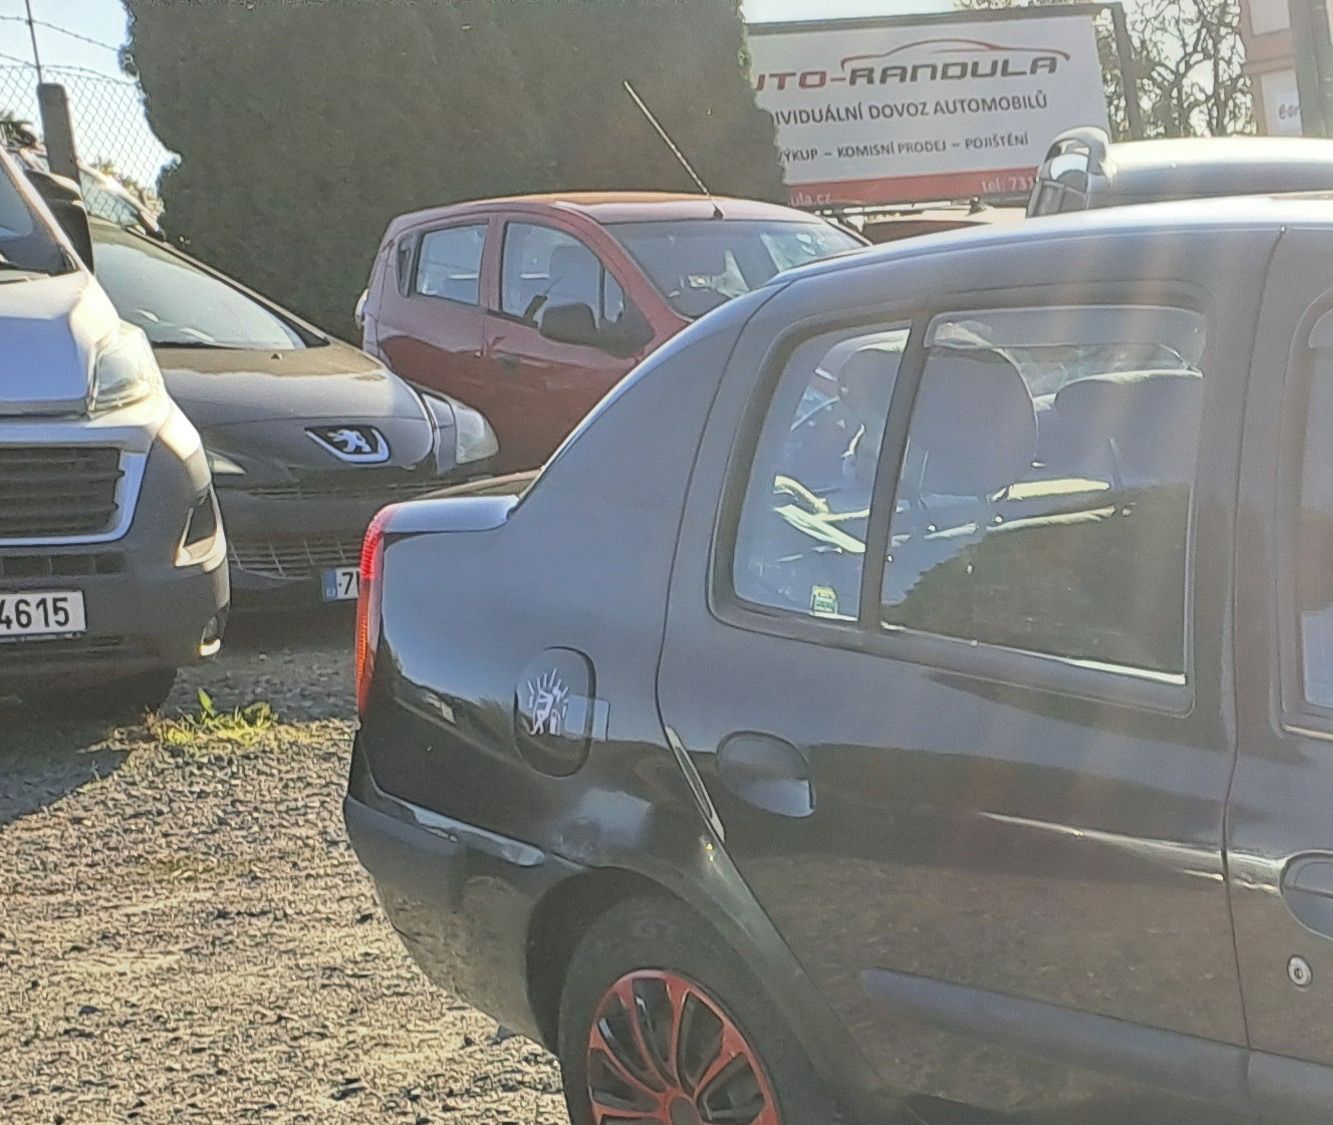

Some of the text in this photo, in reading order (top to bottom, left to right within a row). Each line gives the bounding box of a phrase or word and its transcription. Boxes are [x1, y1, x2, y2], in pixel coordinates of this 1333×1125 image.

[771, 90, 1048, 125] IVIDUÁLNÍ DOVOZ AUTOMOBILŮ
[837, 141, 894, 158] KOMISNÍ
[898, 140, 946, 155] PRODEJ
[965, 131, 1029, 150] POJIŠTĚNÍ
[0, 597, 70, 630] 4615
